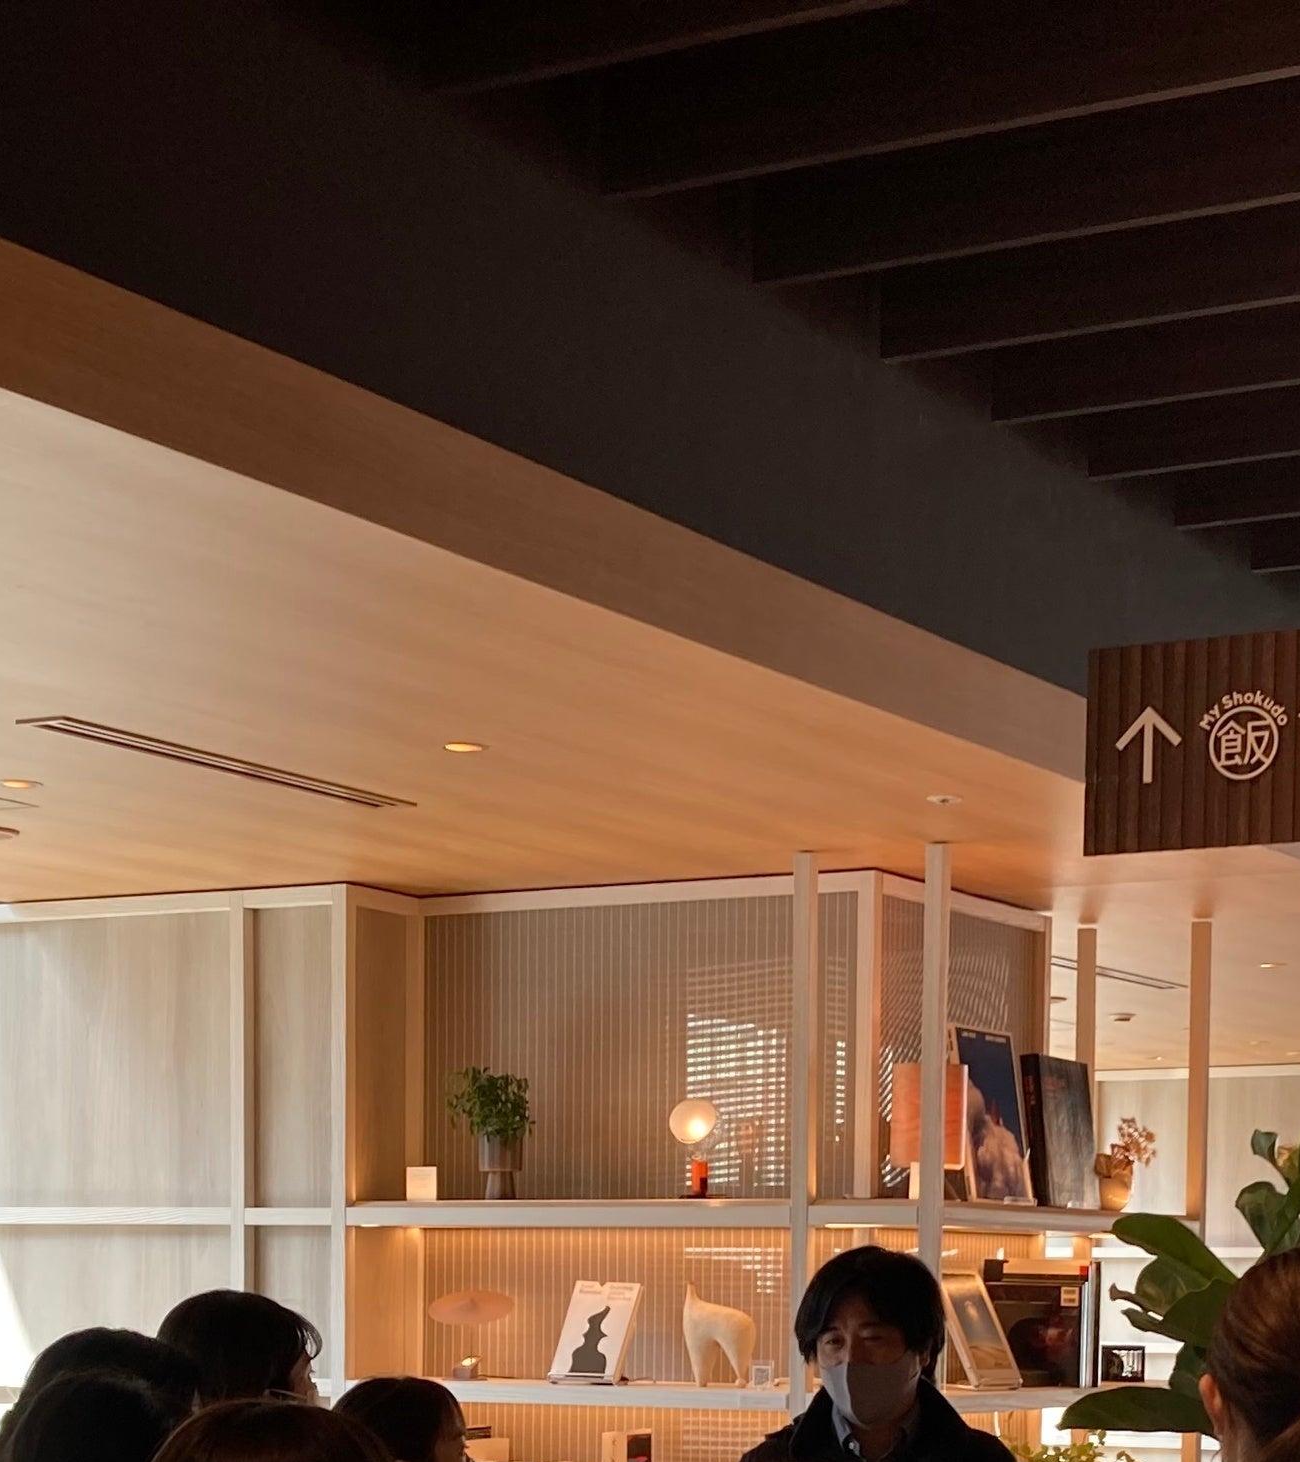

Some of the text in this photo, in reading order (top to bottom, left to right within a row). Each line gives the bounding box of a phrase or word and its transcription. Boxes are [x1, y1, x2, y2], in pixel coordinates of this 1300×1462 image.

[1200, 690, 1288, 730] My Shokudo
[1216, 719, 1271, 766] 飯
